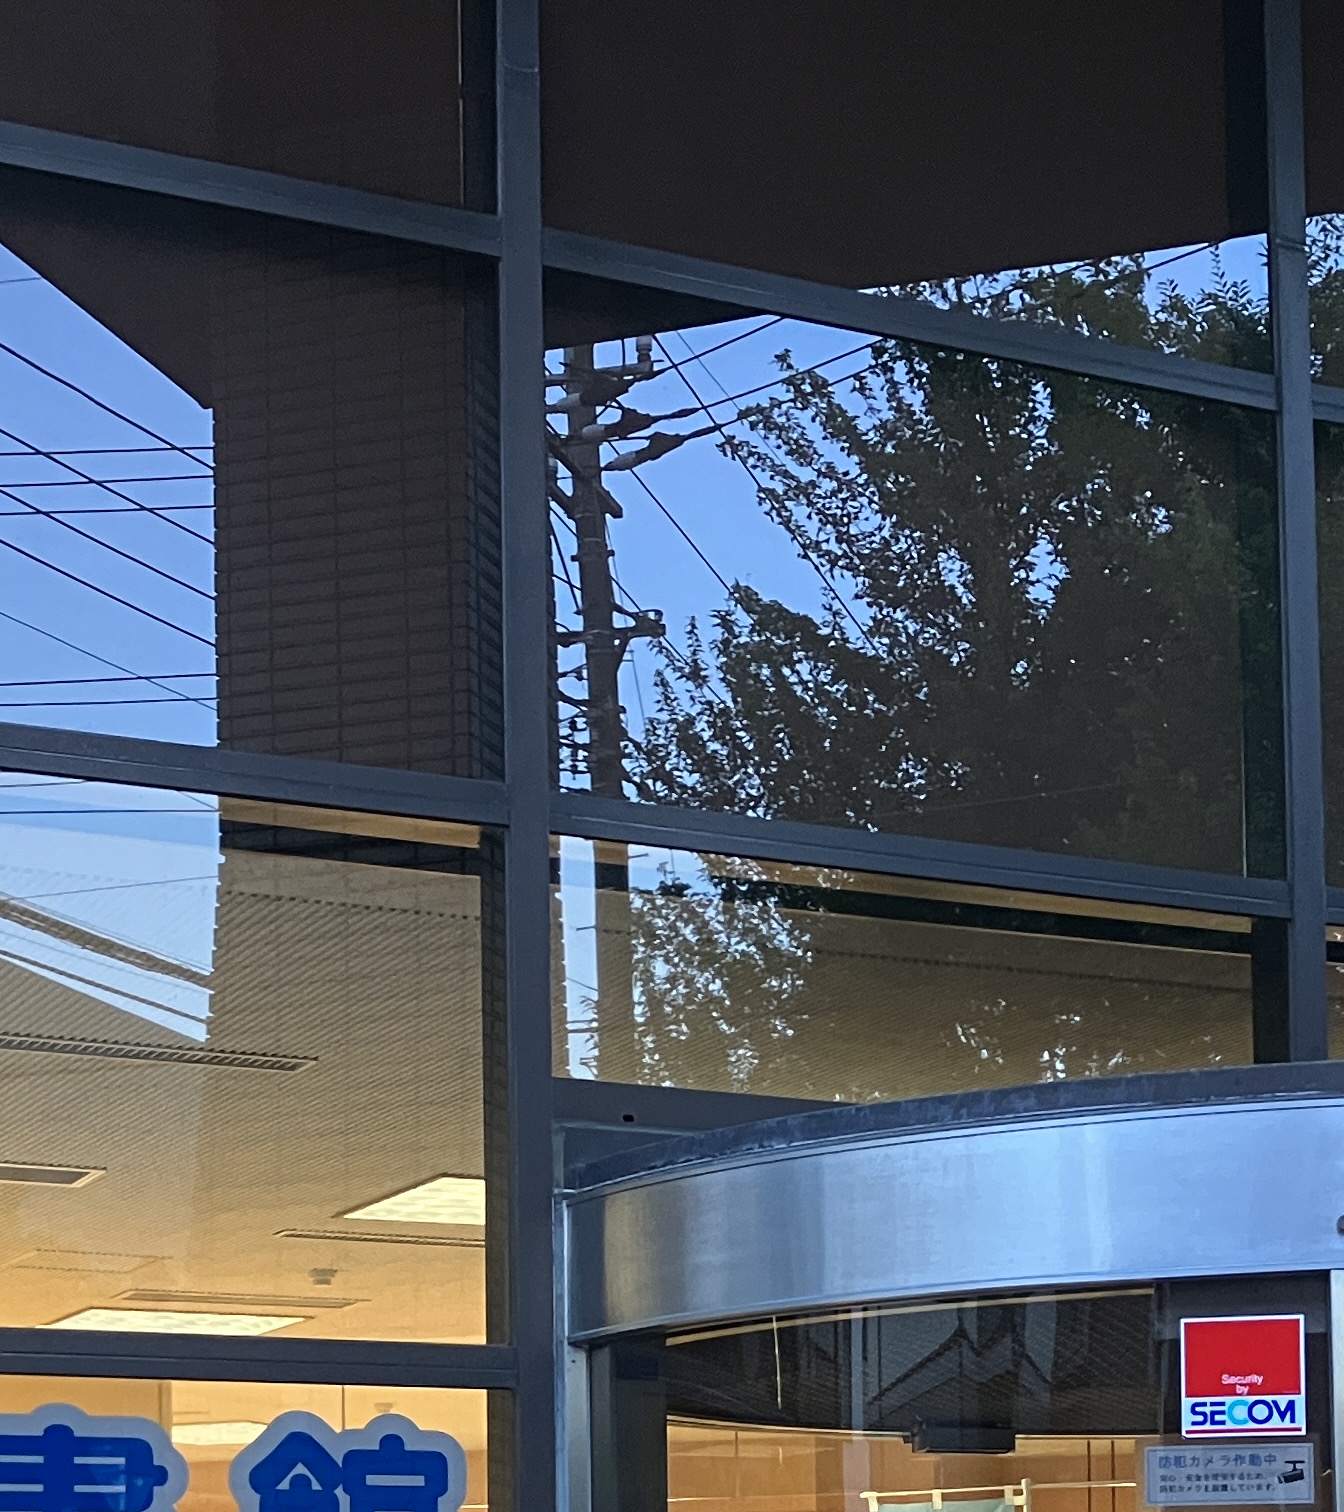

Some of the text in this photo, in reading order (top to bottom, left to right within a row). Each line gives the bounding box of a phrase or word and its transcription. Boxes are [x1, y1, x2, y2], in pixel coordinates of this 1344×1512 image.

[1221, 1373, 1264, 1386] Security
[1235, 1384, 1250, 1395] by
[1190, 1399, 1296, 1426] SECOM
[1158, 1453, 1277, 1469] 防犯カメラ作動中
